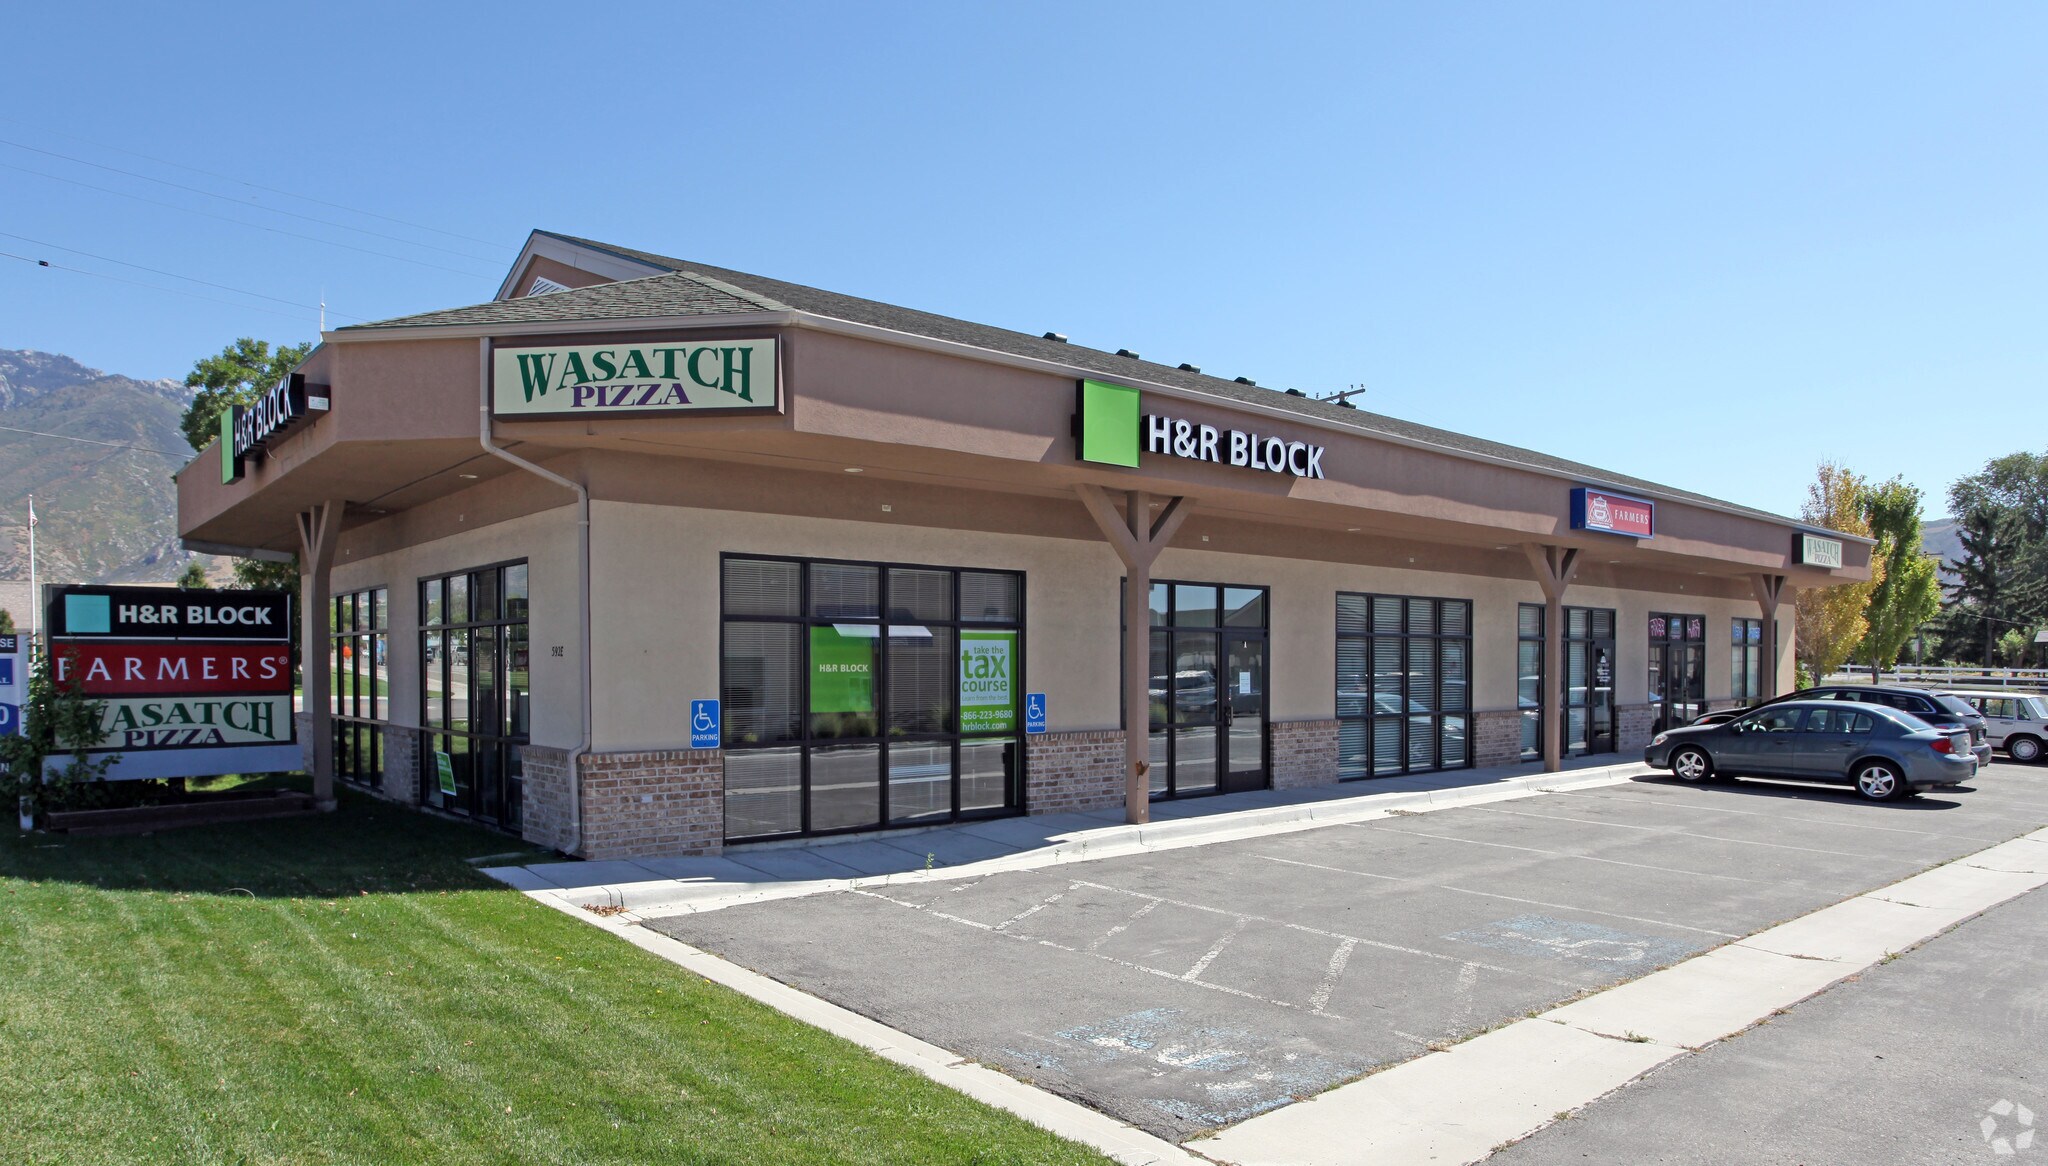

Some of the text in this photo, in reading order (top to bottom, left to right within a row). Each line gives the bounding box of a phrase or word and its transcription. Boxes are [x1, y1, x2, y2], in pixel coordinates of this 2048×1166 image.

[516, 347, 754, 404] WASATCH
[571, 383, 692, 408] PIZZA
[234, 373, 293, 458] H&R BLOCK
[1148, 414, 1325, 480] H&R BLOCK
[1614, 509, 1650, 525] FARMERS
[1806, 538, 1840, 565] WASATCH
[1814, 553, 1832, 565] PIZZA
[119, 604, 272, 625] H&R BLOCK
[973, 645, 1004, 655] take the
[819, 664, 868, 673] H&R BLOCK
[961, 649, 1007, 679] tax
[961, 680, 1008, 692] course
[962, 721, 1008, 731] hrblock.com
[124, 728, 226, 747] PIZZA
